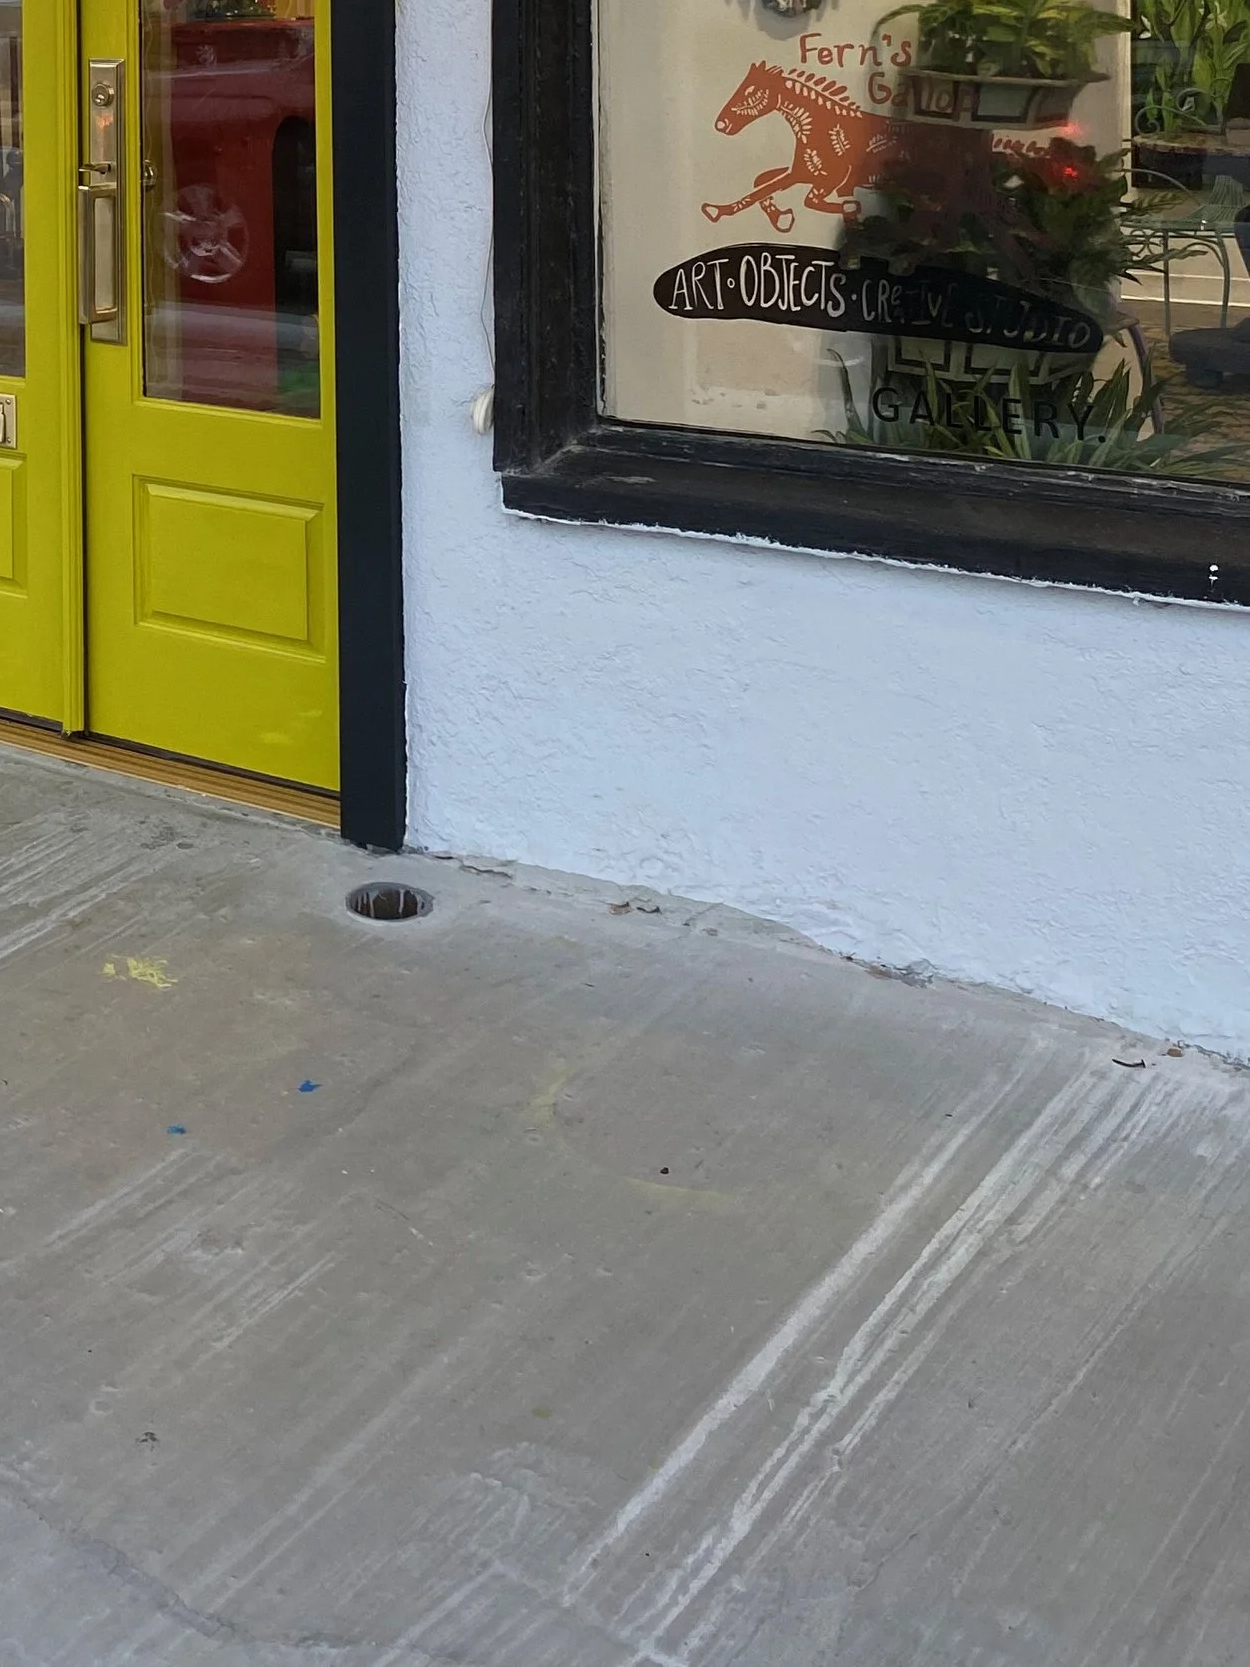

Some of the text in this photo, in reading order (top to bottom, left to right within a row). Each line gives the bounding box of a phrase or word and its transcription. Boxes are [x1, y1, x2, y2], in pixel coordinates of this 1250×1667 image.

[799, 32, 912, 68] Fern's
[668, 258, 729, 310] ART
[739, 252, 846, 318] OBJECTS
